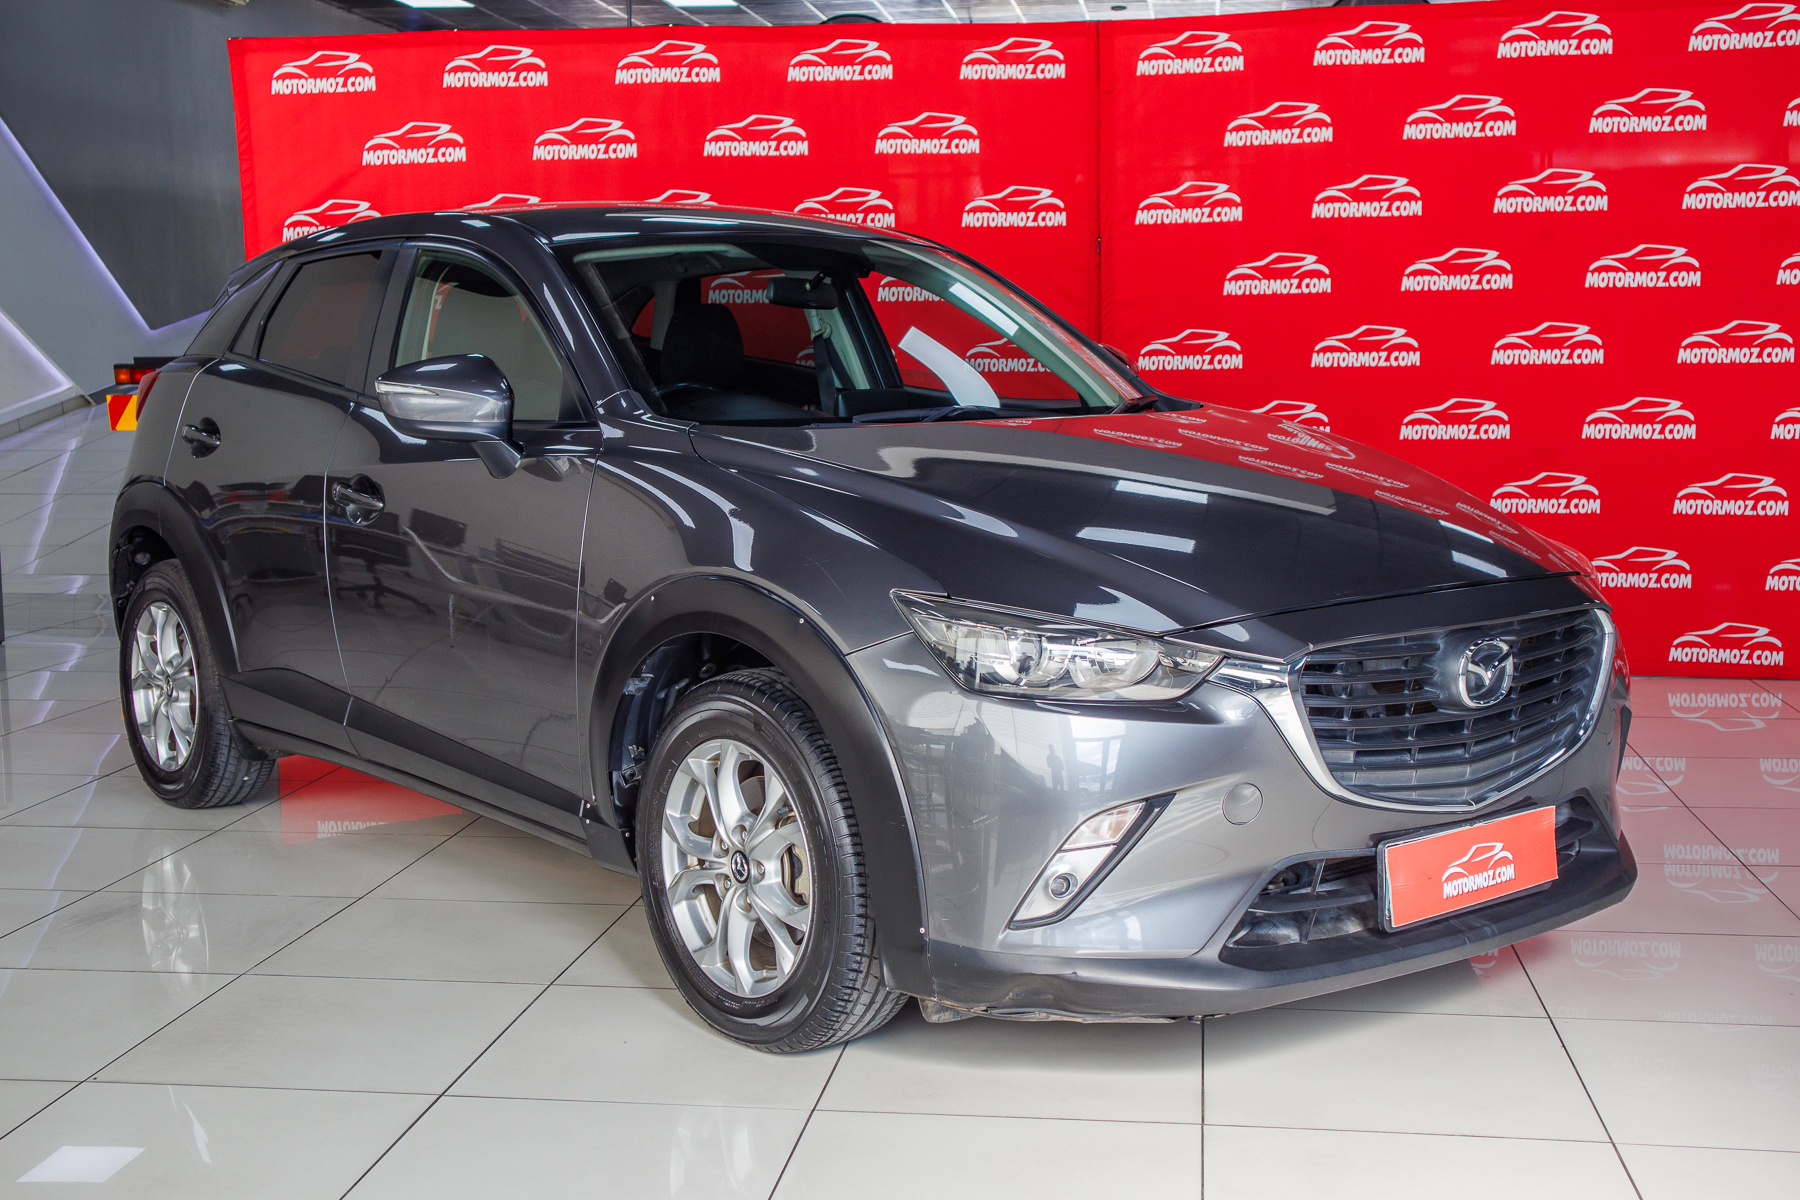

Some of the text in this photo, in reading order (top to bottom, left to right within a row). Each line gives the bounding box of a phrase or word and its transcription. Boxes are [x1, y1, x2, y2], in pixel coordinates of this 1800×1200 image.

[1312, 46, 1425, 66] MOTORMOZ.COM
[1496, 38, 1614, 59] MOTORMOZ.COM
[787, 64, 893, 82] MOTORMOZ.COM
[959, 63, 1066, 80] MOTORMOZ.COM
[1136, 55, 1244, 76] MOTORMOZ.COM
[271, 75, 377, 95] MOTORMOZ.COM
[442, 70, 549, 88] MOTORMOZ.COM
[614, 66, 721, 85] MOTORMOZ.COM
[1402, 119, 1517, 140] MOTORMOZ.COM
[1588, 114, 1707, 134] MOTORMOZ.COM
[874, 138, 980, 154] MOTORMOZ.COM
[1223, 126, 1333, 147] MOTORMOZ.COM
[361, 146, 467, 166] MOTORMOZ.COM
[532, 142, 638, 161] MOTORMOZ.COM
[703, 140, 809, 157] MOTORMOZ.COM
[1311, 200, 1423, 219] MOTORMOZ.COM
[1493, 195, 1608, 214] MOTORMOZ.COM
[1681, 190, 1800, 210] MOTORMOZ.COM
[961, 211, 1067, 228] MOTORMOZ.COM
[1134, 205, 1243, 225] MOTORMOZ.COM
[1222, 277, 1332, 296] MOTORMOZ.COM
[1400, 273, 1513, 292] MOTORMOZ.COM
[1584, 270, 1702, 288] MOTORMOZ.COM
[1137, 353, 1243, 371] MOTORMOZ.COM
[1310, 350, 1421, 368] MOTORMOZ.COM
[1490, 348, 1604, 365] MOTORMOZ.COM
[1676, 346, 1795, 364] MOTORMOZ.COM
[1399, 423, 1511, 440] MOTORMOZ.COM
[1581, 423, 1697, 440] MOTORMOZ.COM
[1489, 498, 1601, 514] MOTORMOZ.COM
[1672, 499, 1789, 516] MOTORMOZ.COM
[1597, 572, 1692, 588] TORMOZ.COM
[1668, 646, 1784, 666] MOTORMOZ.COM
[1443, 863, 1515, 899] MOTORMOZ.COM
